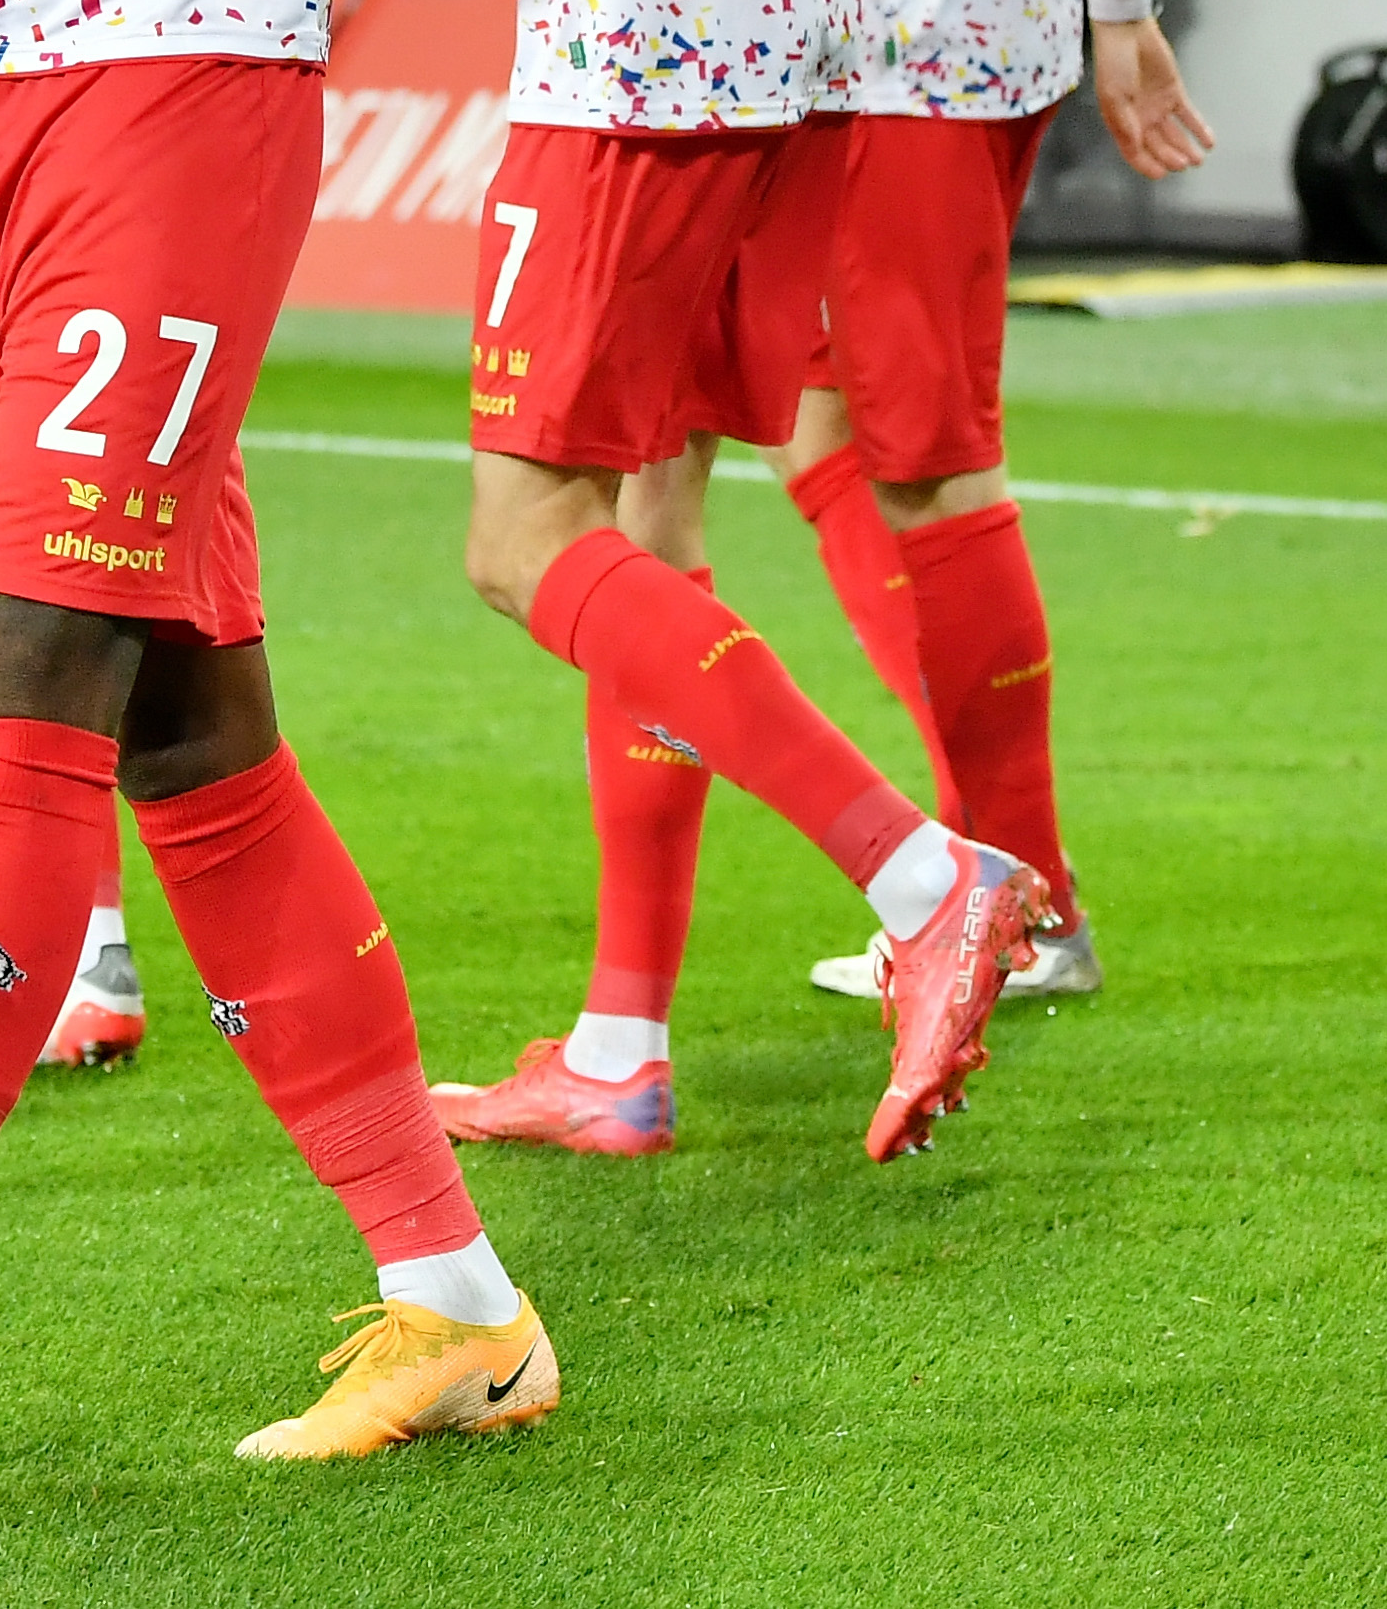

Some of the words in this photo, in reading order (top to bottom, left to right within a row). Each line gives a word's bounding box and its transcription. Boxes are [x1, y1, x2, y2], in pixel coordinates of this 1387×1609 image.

[487, 201, 538, 328] 7
[36, 308, 218, 466] 27
[43, 531, 165, 572] uhlsport
[953, 886, 987, 1005] ULTRA
